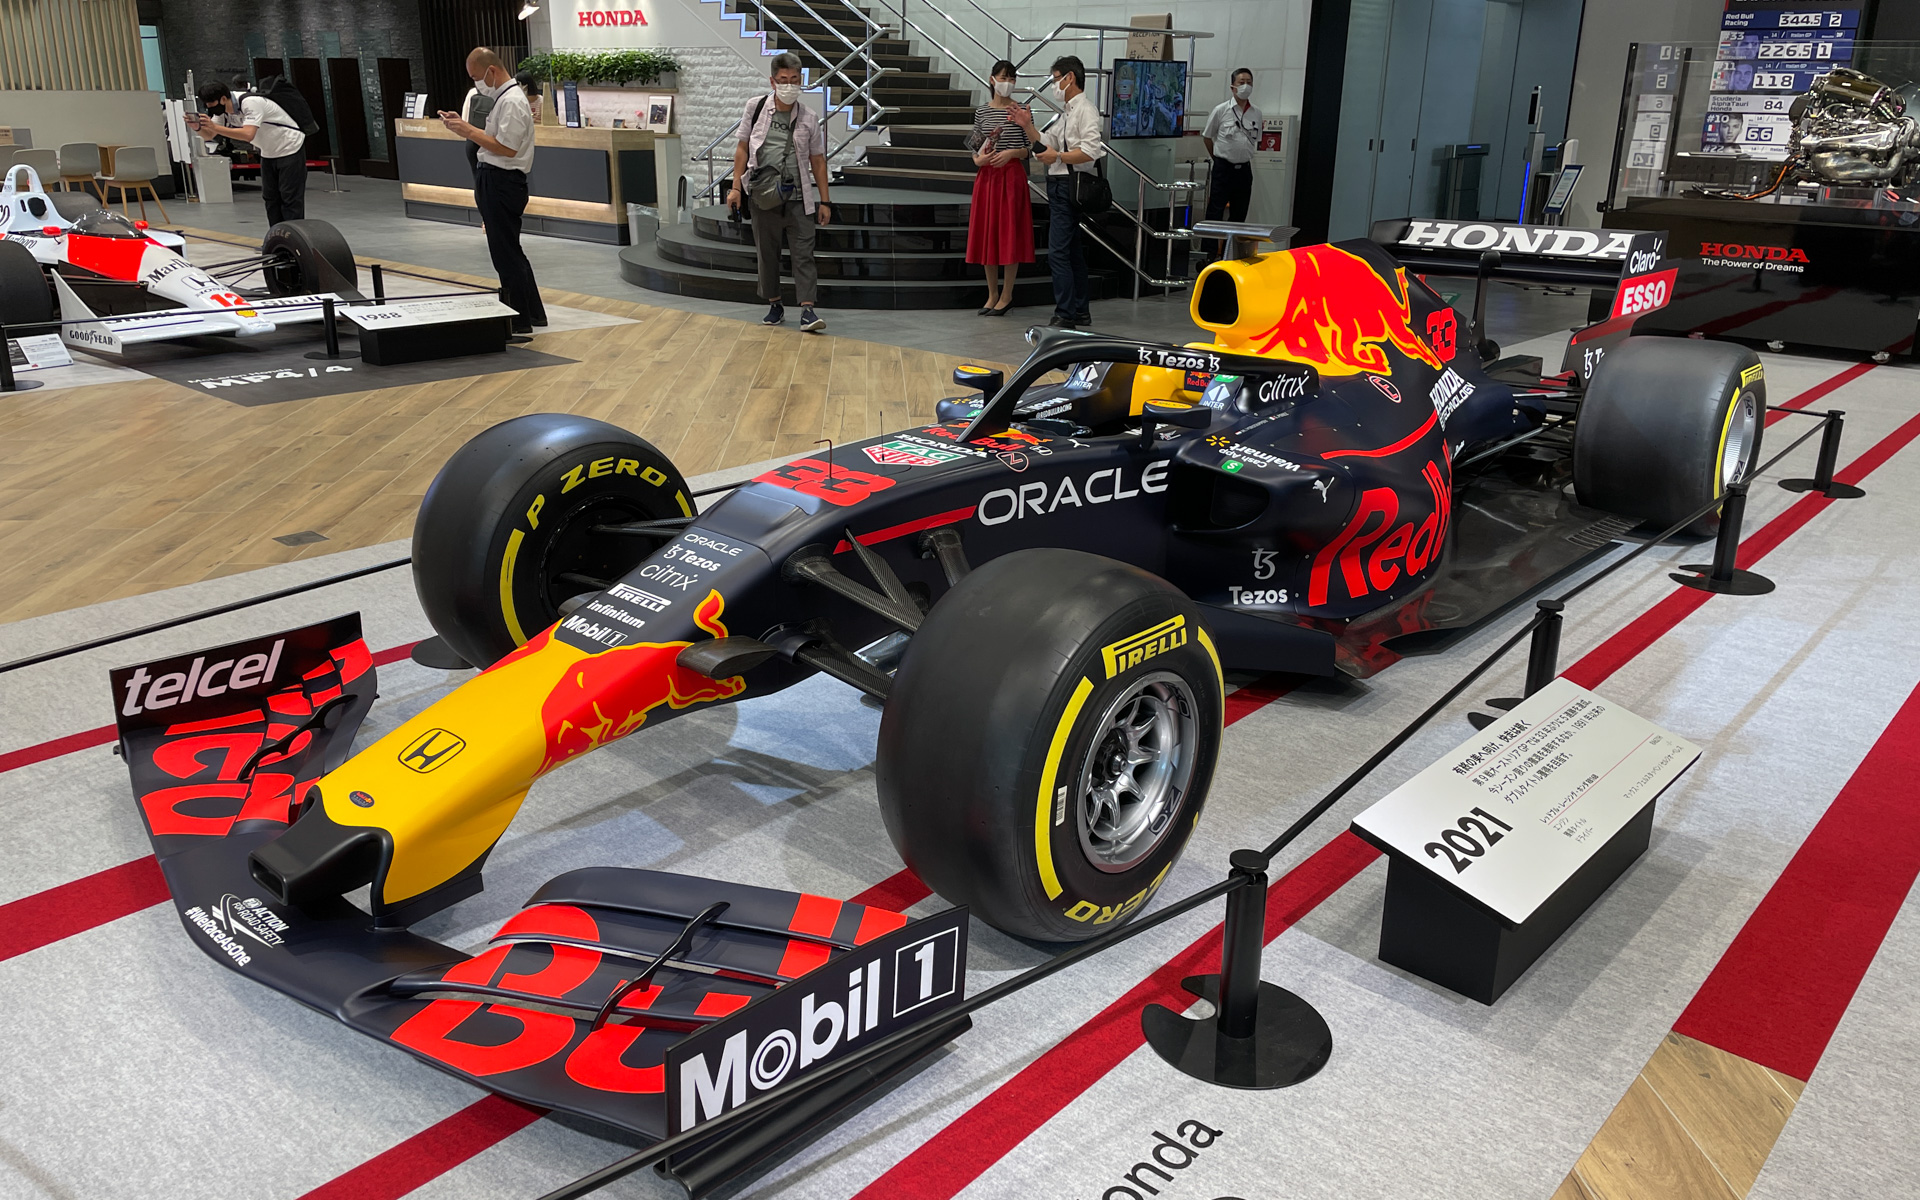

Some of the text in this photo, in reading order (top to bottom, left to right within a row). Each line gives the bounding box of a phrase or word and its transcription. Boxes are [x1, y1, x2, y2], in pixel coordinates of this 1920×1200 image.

[578, 10, 648, 27] HONDA
[1780, 14, 1821, 26] 344.5
[1831, 15, 1841, 25] 2
[1760, 45, 1811, 57] 226.5
[1818, 45, 1829, 57] 1
[1755, 75, 1793, 87] 118
[1764, 100, 1784, 110] 84
[1706, 114, 1730, 123] #10
[1747, 128, 1773, 140] 66
[1399, 221, 1635, 260] HONDA
[1699, 242, 1810, 263] HONDA
[1630, 249, 1656, 274] Claro
[1702, 257, 1805, 273] The Power of Dreams
[210, 292, 252, 308] 12
[1621, 279, 1667, 315] ESSO
[357, 312, 402, 321] 1988
[1426, 306, 1458, 364] 33
[1157, 349, 1206, 370] Tezos
[1073, 380, 1093, 390] INTER
[1429, 366, 1465, 416] HONDA
[1203, 400, 1225, 409] INTER
[888, 442, 958, 462] TAG
[893, 433, 989, 459] HONDA
[969, 437, 1026, 452] Bull
[1219, 448, 1268, 469] Cash App
[1229, 442, 1301, 473] Walmart
[526, 456, 668, 531] P ZERO
[751, 458, 898, 507] 33
[977, 459, 1171, 526] ORACLE
[683, 533, 744, 558] ORACLE
[678, 548, 722, 572] Tezos
[607, 582, 672, 613] PIRELLI
[1228, 585, 1288, 606] Tezos
[586, 600, 646, 629] infinitum
[562, 614, 610, 642] Mobil
[1101, 614, 1188, 680] PIRELLI
[121, 639, 286, 717] telcel
[1424, 806, 1514, 875] 2021
[237, 908, 286, 946] ROAD SAFETY
[252, 907, 290, 932] ACTION
[184, 906, 252, 967] #WeRaceAsOne
[679, 942, 936, 1132] Mobil 1
[1099, 1119, 1224, 1200] onda
